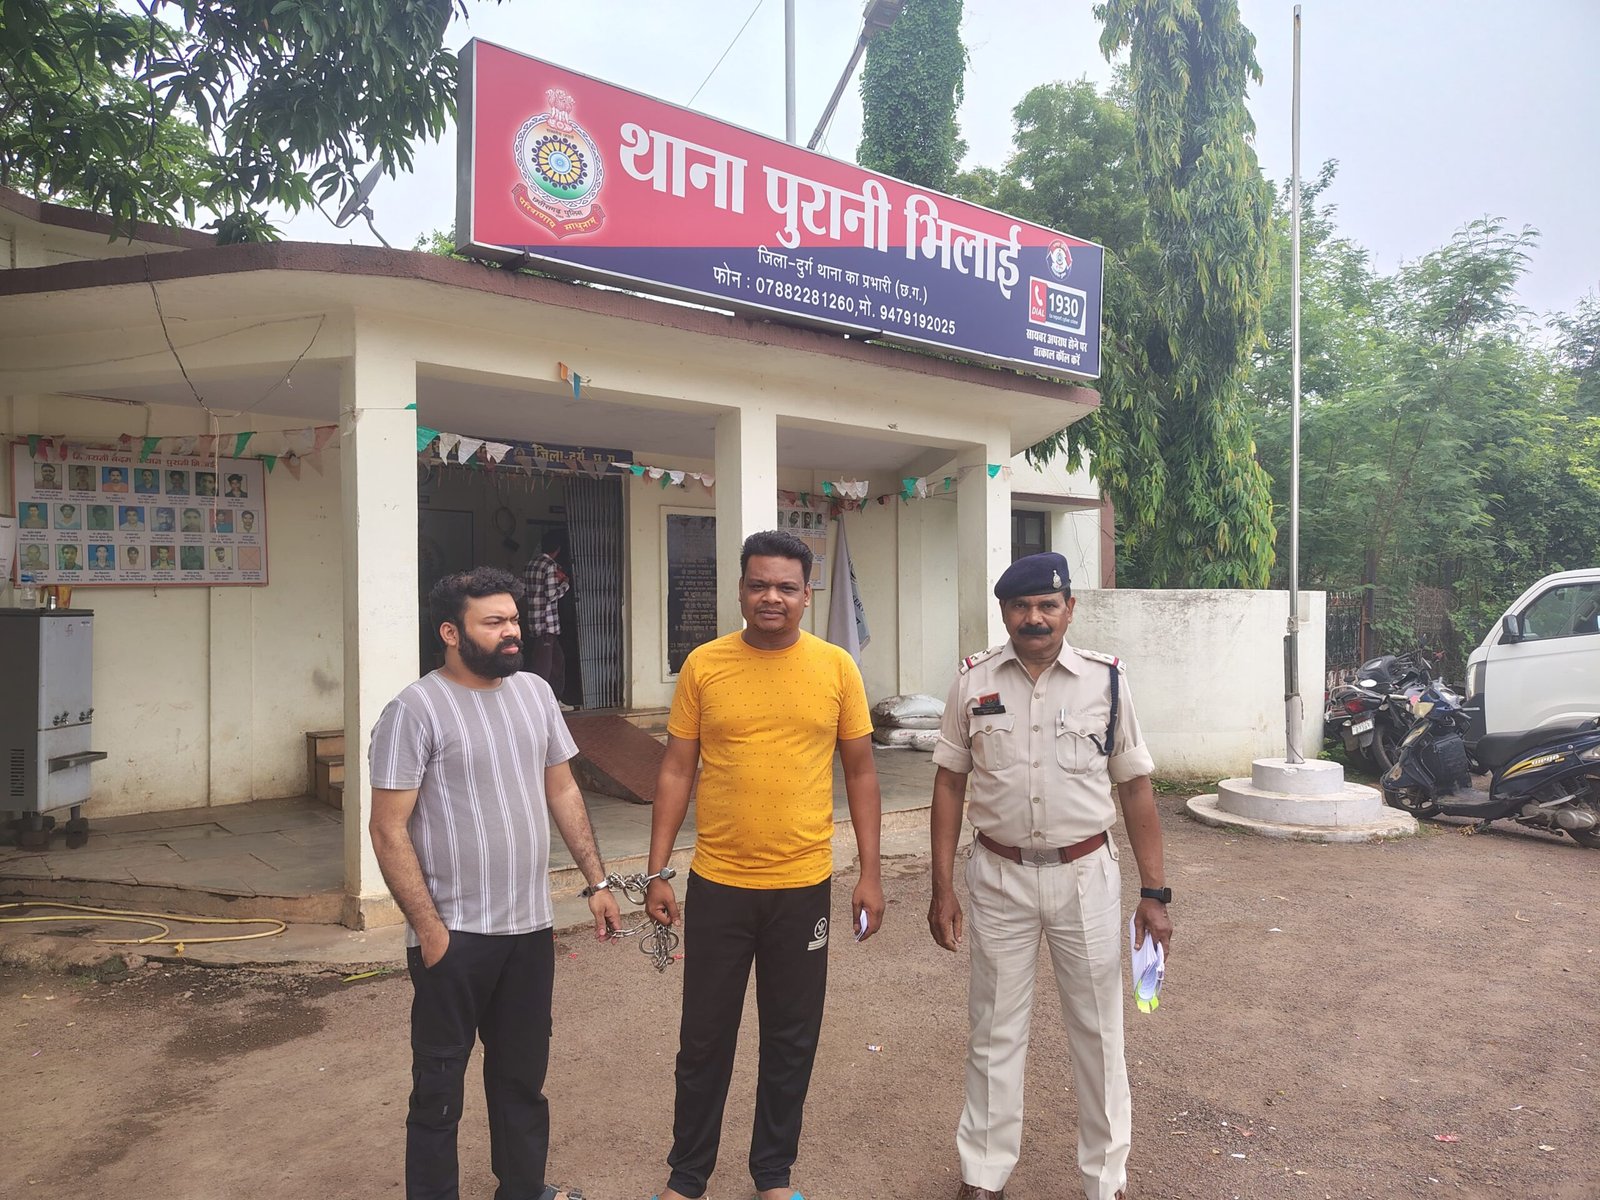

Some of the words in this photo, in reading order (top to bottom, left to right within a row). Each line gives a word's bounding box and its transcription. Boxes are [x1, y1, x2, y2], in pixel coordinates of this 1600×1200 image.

[620, 122, 748, 215] थाना
[762, 165, 892, 253] पुरानी
[904, 194, 1022, 300] भिलाई
[758, 245, 813, 279] जिला-दुर्ग
[818, 264, 842, 282] थाना
[845, 270, 859, 286] का
[862, 275, 891, 294] प्रभारी
[895, 279, 928, 306] (छ.ग.)
[713, 262, 742, 288] फोन
[880, 305, 956, 335] 9479192025
[1031, 306, 1046, 317] DIAL
[1049, 292, 1079, 318] 1930
[1026, 328, 1047, 343] सायबर
[1047, 333, 1068, 348] अपराध
[1068, 336, 1079, 351] होने
[1079, 341, 1088, 353] पर
[1033, 346, 1055, 360] तत्काल
[1056, 349, 1070, 364] कॉल
